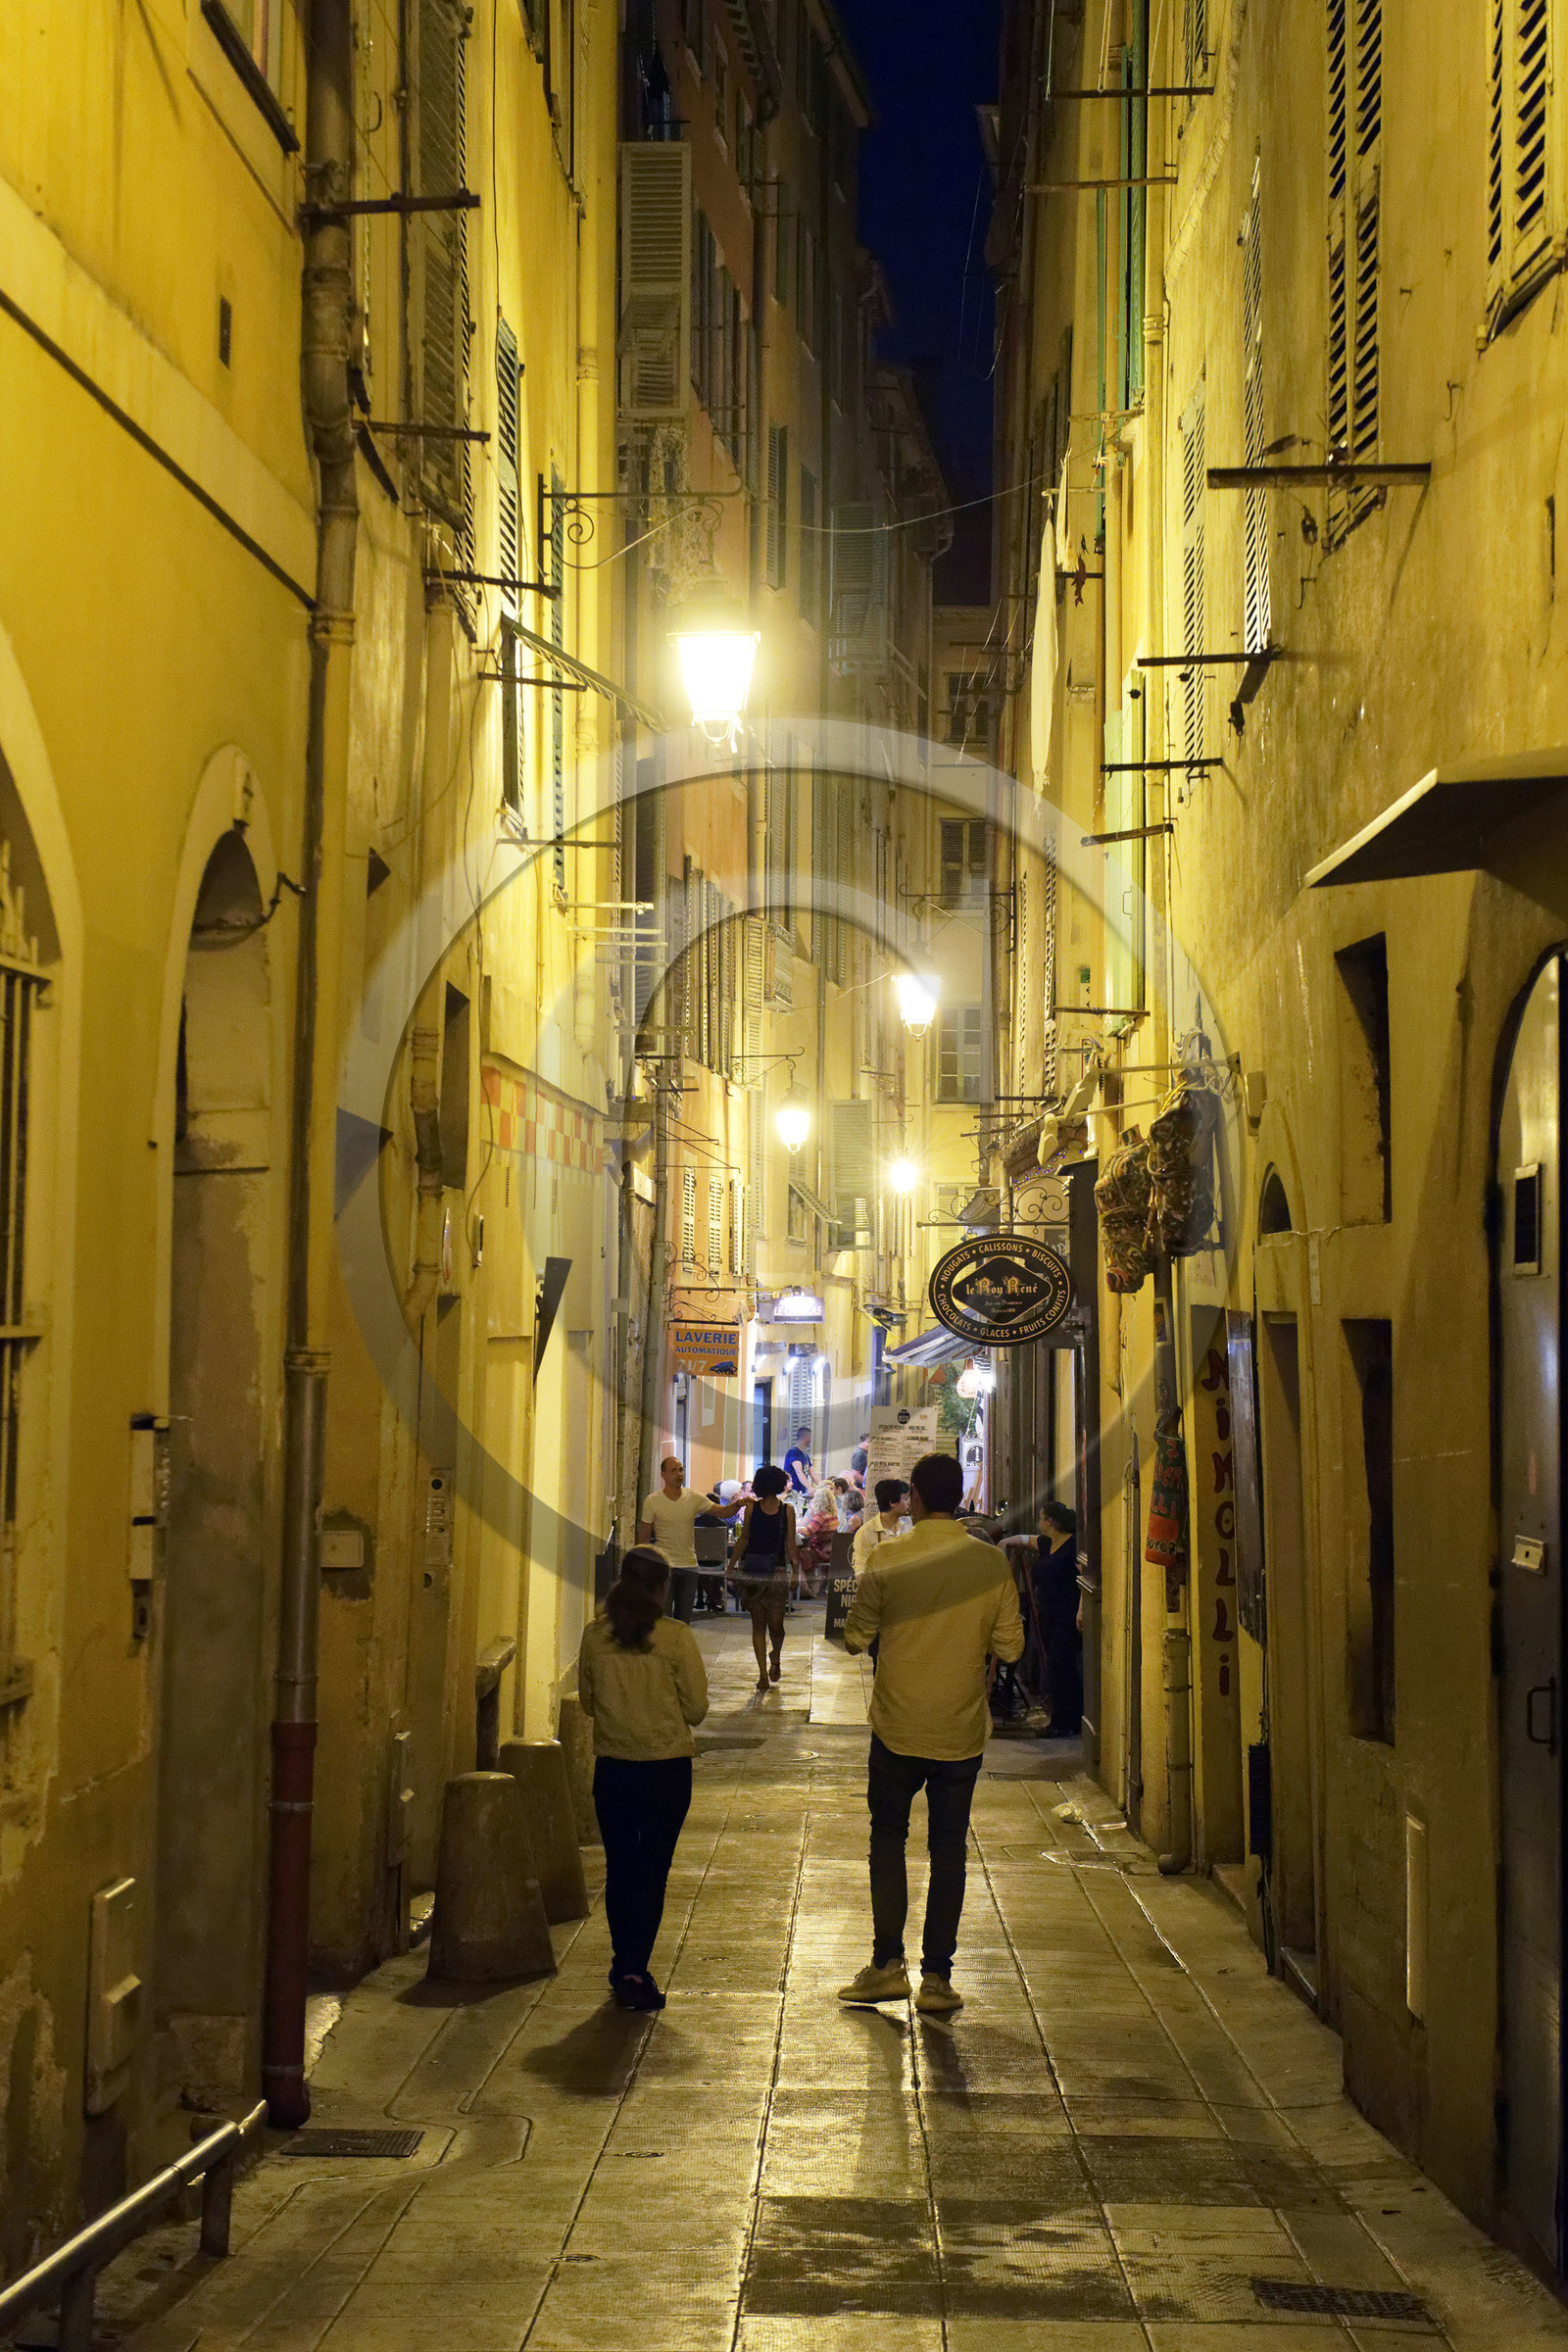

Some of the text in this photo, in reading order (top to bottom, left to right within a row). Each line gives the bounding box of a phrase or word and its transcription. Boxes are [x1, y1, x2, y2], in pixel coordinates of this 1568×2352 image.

[978, 1242, 1023, 1253] CALISSONS
[941, 1251, 971, 1283] NOUGATS
[1031, 1249, 1062, 1279] BISCUITS
[965, 1276, 1038, 1298] le Roy René
[938, 1293, 972, 1332] CHOCOLATS
[1019, 1317, 1047, 1335] FRUITS
[1045, 1290, 1066, 1321] CONFITS
[675, 1331, 737, 1345] LAVERIE
[980, 1327, 1010, 1338] GLACES
[674, 1346, 737, 1356] AUTOMATIQUE
